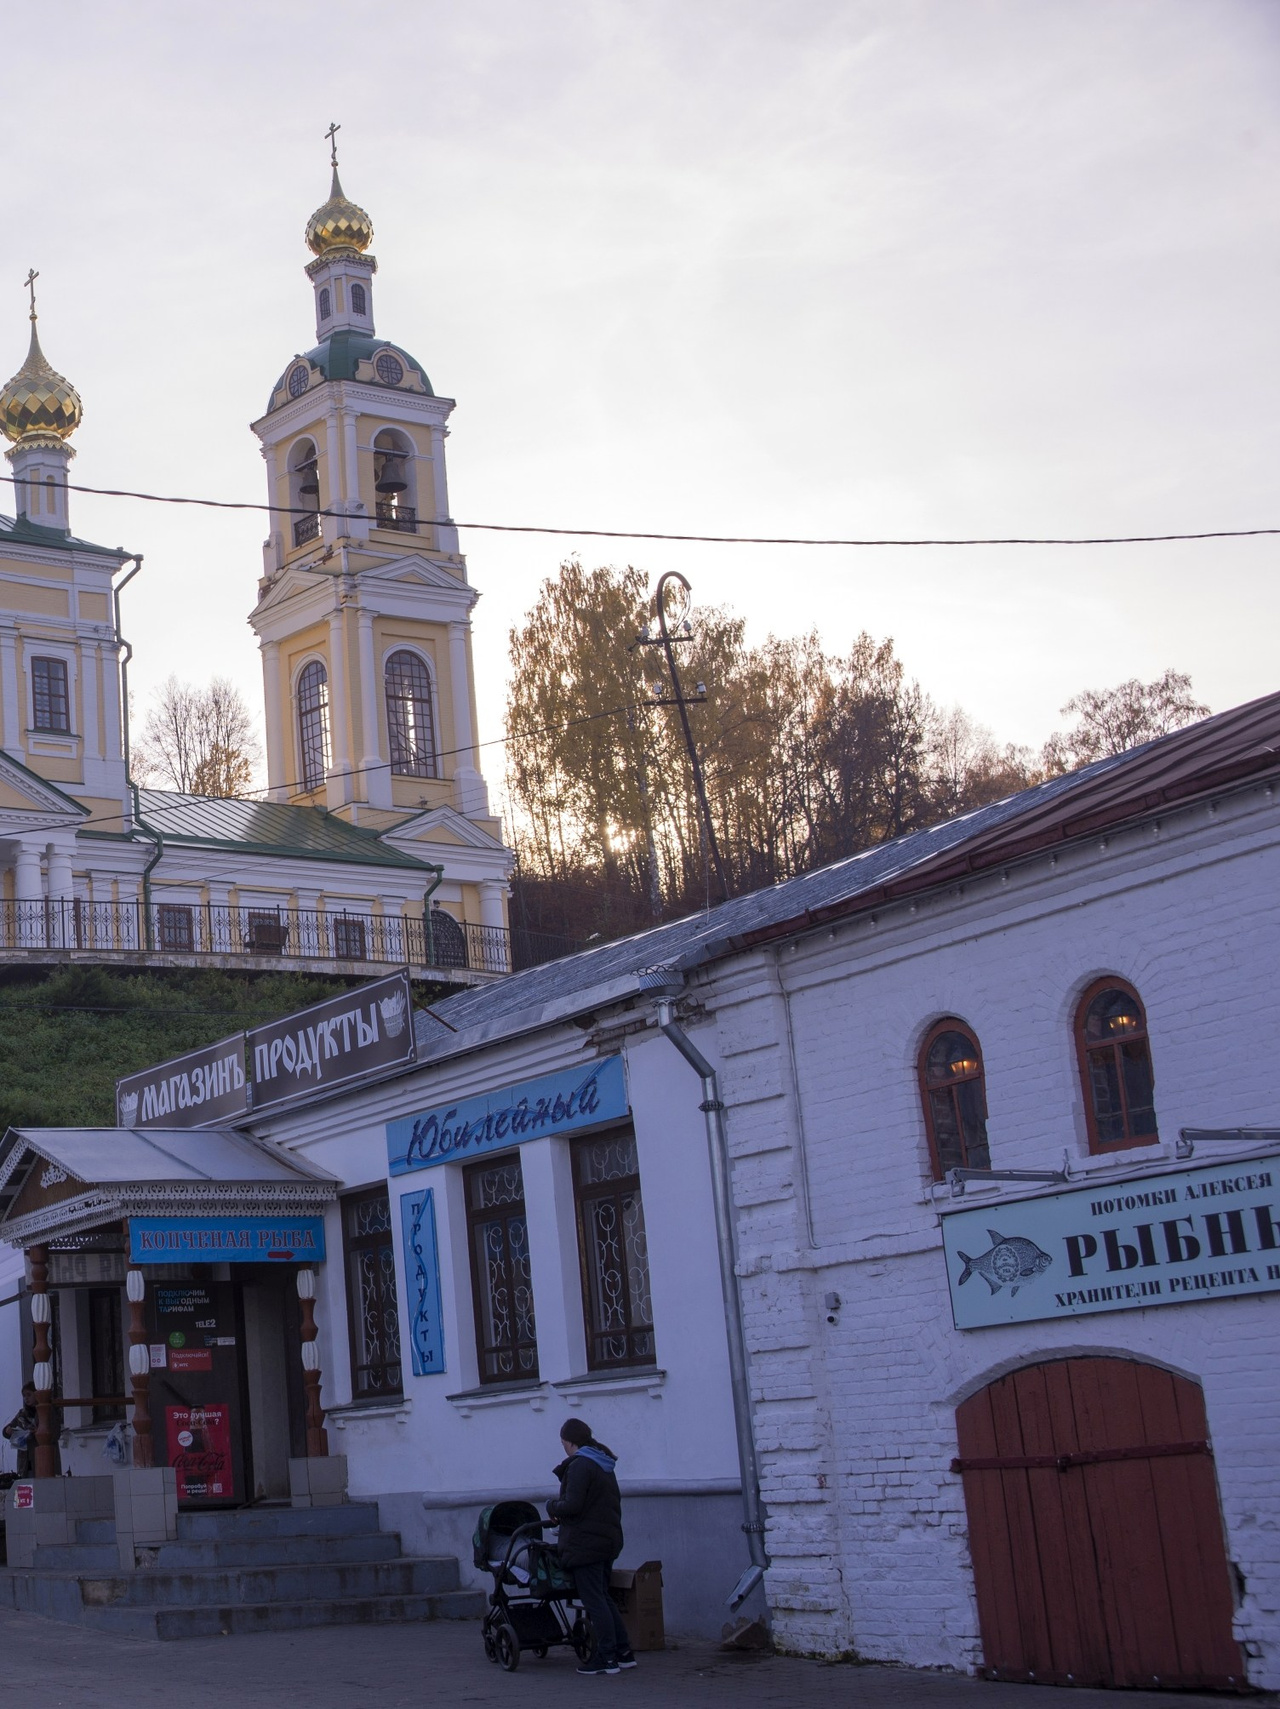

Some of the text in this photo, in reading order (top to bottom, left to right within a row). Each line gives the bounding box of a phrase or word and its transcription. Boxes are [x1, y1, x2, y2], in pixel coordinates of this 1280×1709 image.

[141, 1003, 380, 1122] МАГАЗИНЪ ПРОДУКТЫ
[407, 1075, 600, 1166] Юбилейный
[1090, 1172, 1272, 1216] ПОТОМКИ АЛЕКСЕЯ
[139, 1230, 316, 1250] КОПЧЕНАЯ РЫБА
[158, 1289, 206, 1298] ПОДКЛЮЧИМ
[411, 1203, 433, 1362] ПРОДУКТЫ
[1055, 1281, 1162, 1308] ХРАНИТЕЛИ
[1168, 1267, 1259, 1294] РЕЦЕПТА
[195, 1319, 216, 1328] TELE2
[190, 1411, 222, 1420] лучшая
